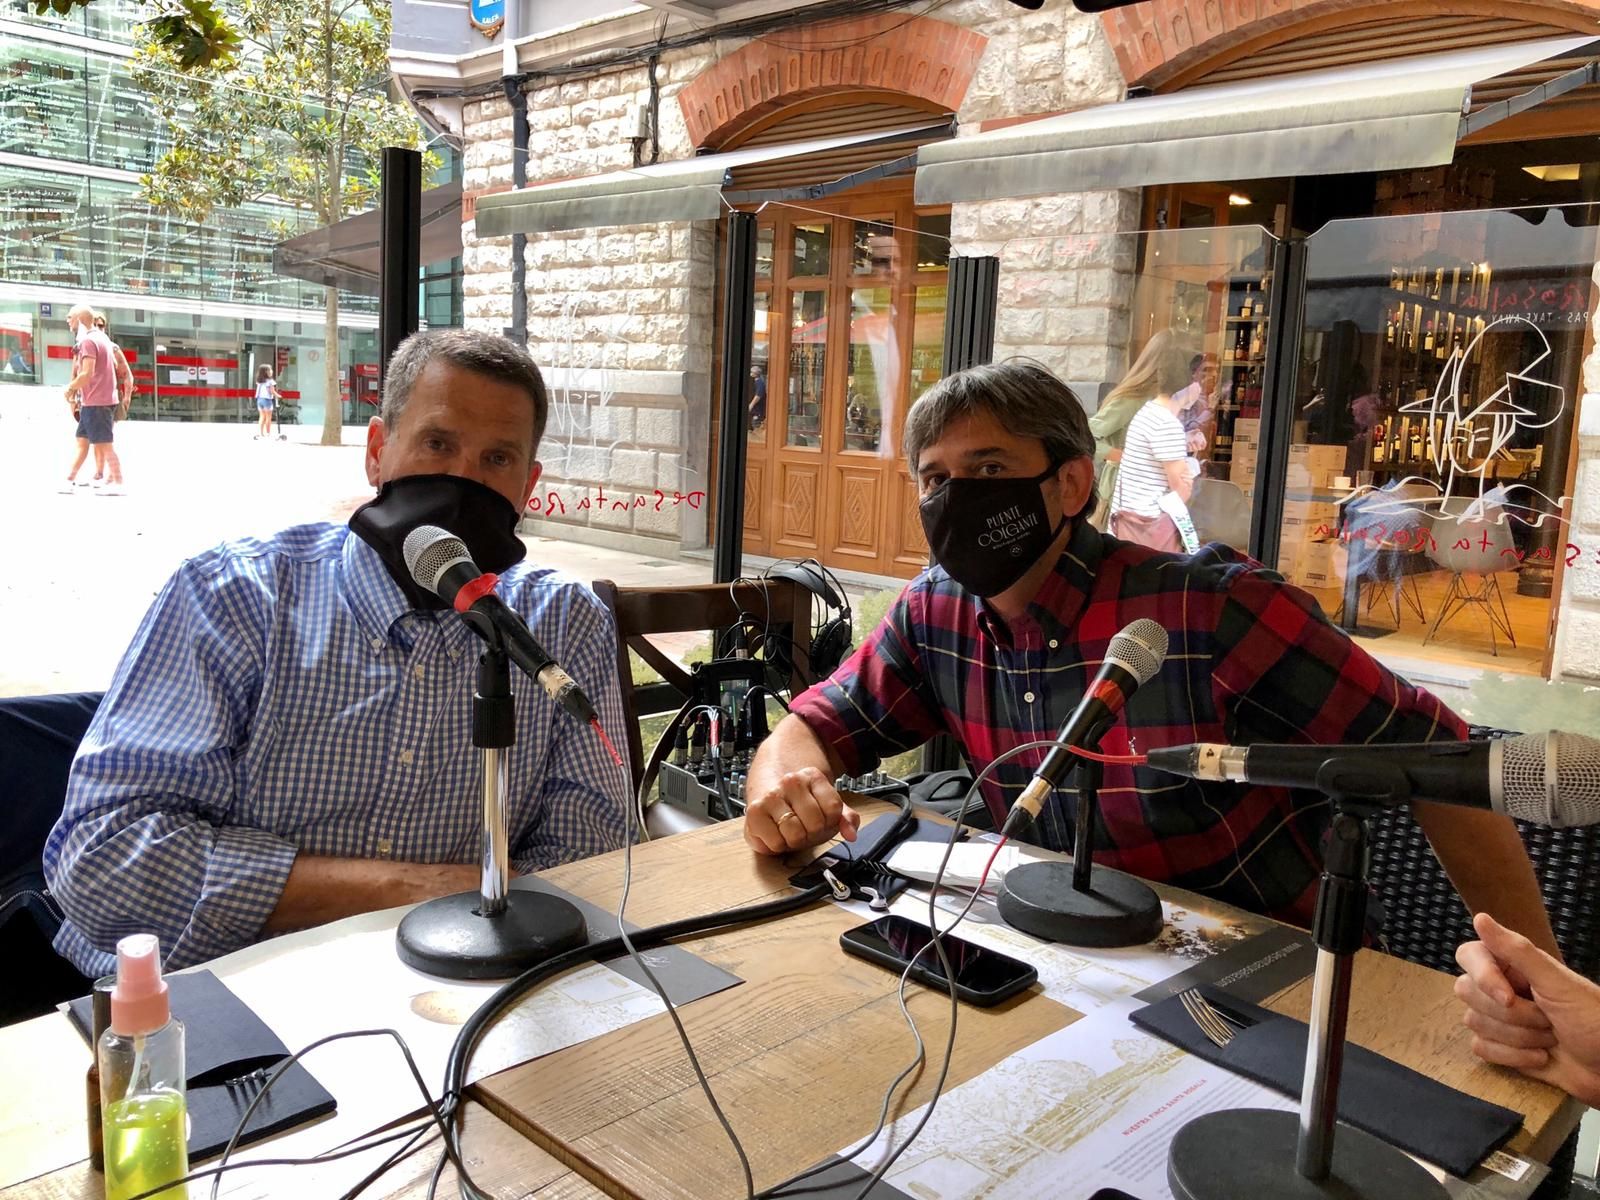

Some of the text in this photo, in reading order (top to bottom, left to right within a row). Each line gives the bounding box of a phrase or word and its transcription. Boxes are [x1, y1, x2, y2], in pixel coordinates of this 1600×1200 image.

[978, 512, 1039, 547] COLGANTE
[986, 505, 1022, 528] PUENTE
[1121, 1116, 1151, 1136] NUESTRA
[1148, 1105, 1168, 1119] FINCA
[1165, 1093, 1185, 1107] SANTA
